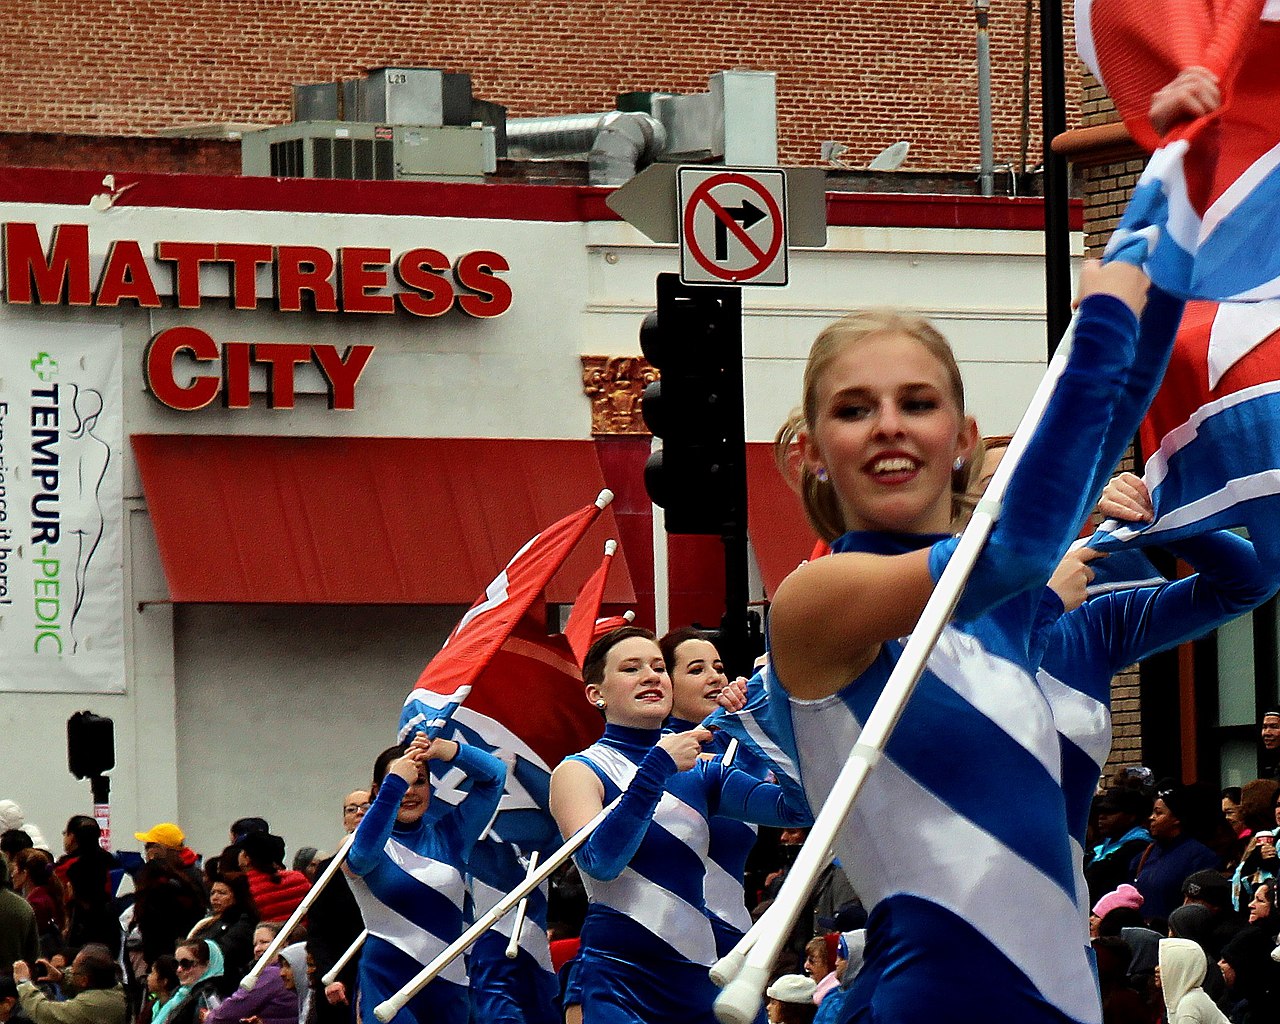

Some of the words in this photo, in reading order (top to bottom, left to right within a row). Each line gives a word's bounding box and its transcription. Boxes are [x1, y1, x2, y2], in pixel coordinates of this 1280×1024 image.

[2, 222, 513, 319] MATTRESS
[146, 326, 375, 411] CITY
[30, 383, 63, 654] TEMPUR-PEDIC
